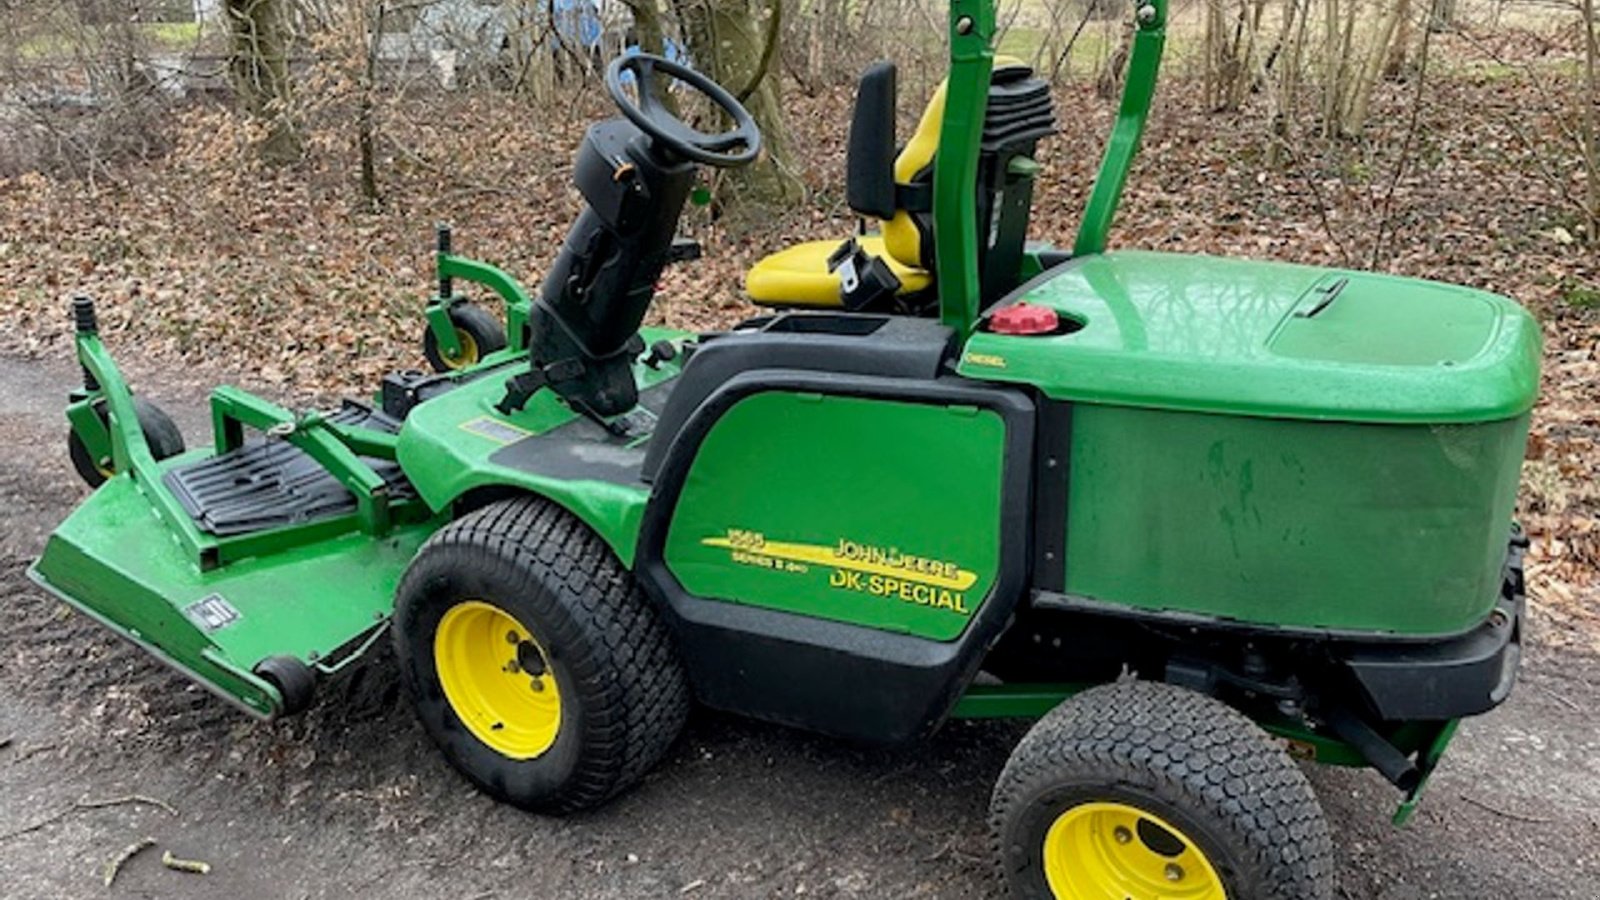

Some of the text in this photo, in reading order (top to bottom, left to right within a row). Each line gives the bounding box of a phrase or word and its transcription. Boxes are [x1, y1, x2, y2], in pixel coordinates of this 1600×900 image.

[834, 537, 958, 579] JOHN DEERE
[829, 569, 969, 614] DK-SPECIAL
